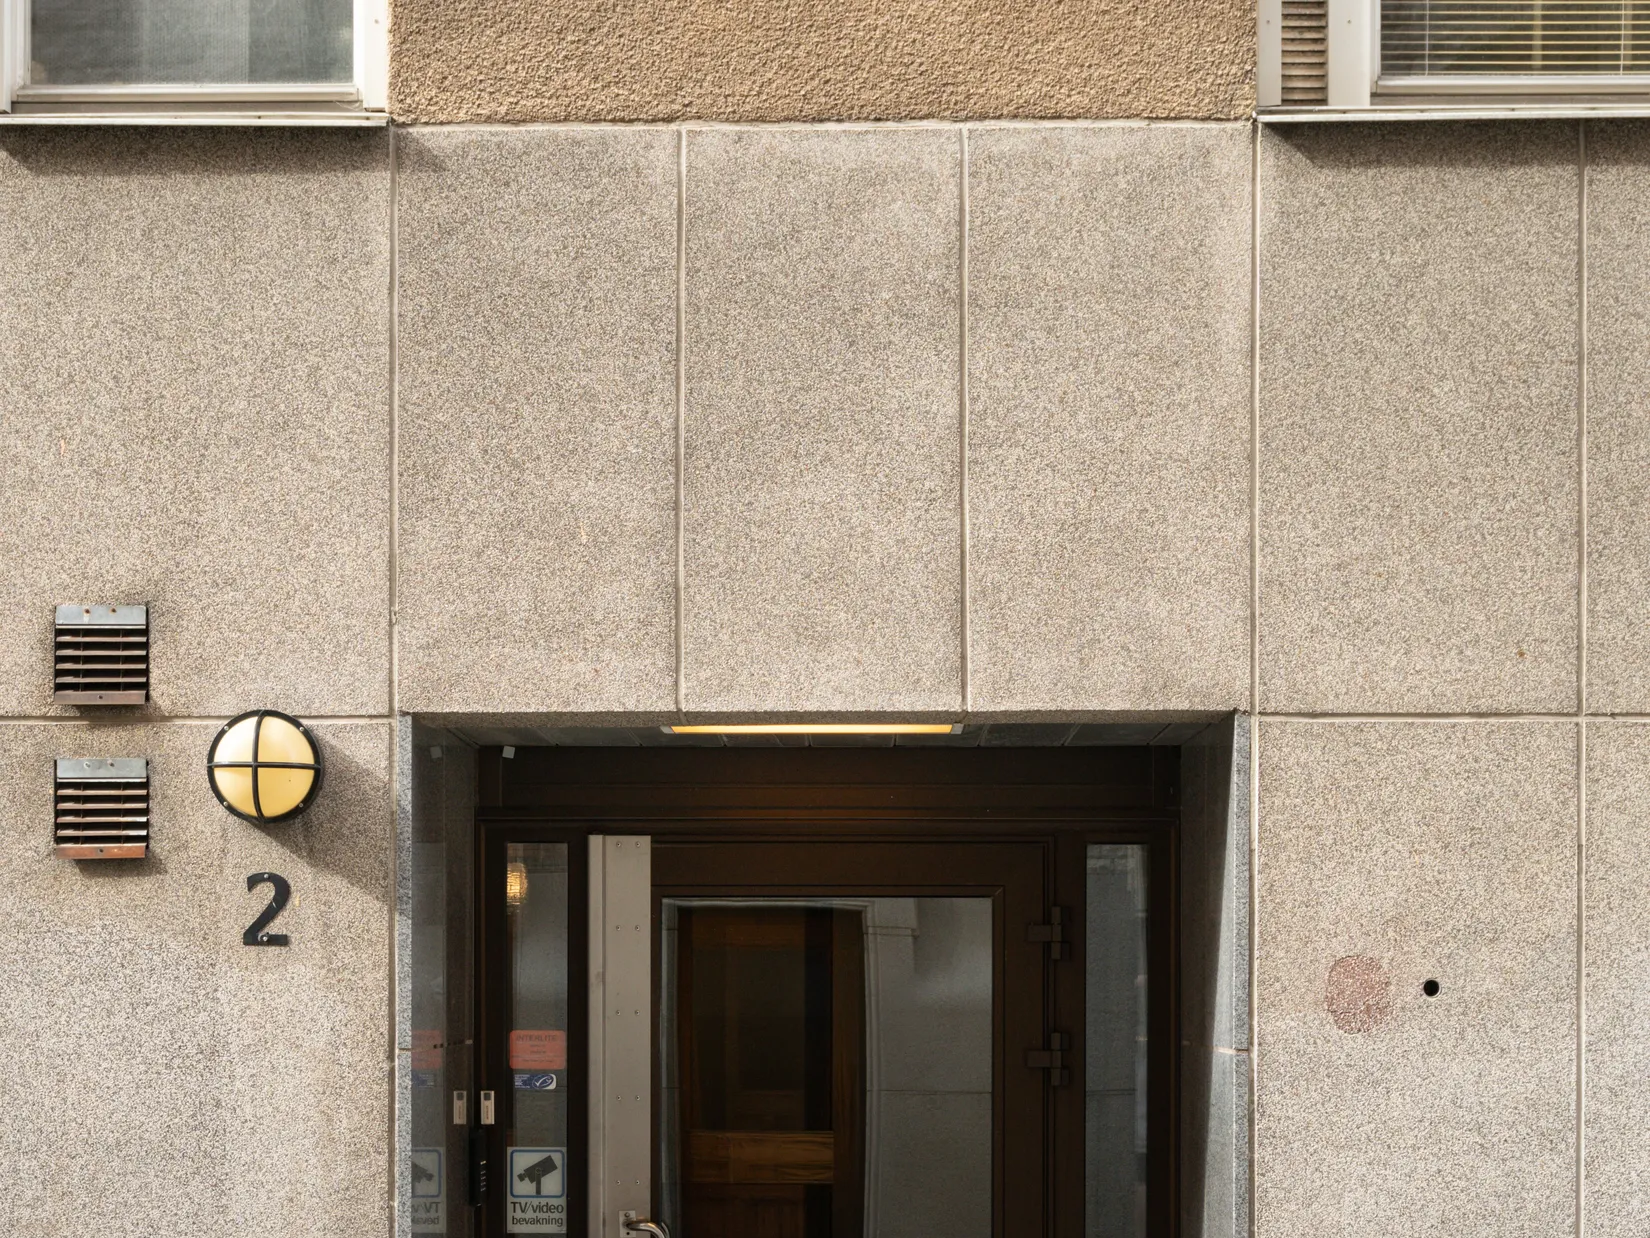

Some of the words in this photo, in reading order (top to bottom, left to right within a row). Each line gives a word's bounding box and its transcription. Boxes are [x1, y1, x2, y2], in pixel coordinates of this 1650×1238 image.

[243, 872, 291, 946] 2
[510, 1201, 564, 1214] TV/video
[511, 1215, 563, 1228] bevakning
